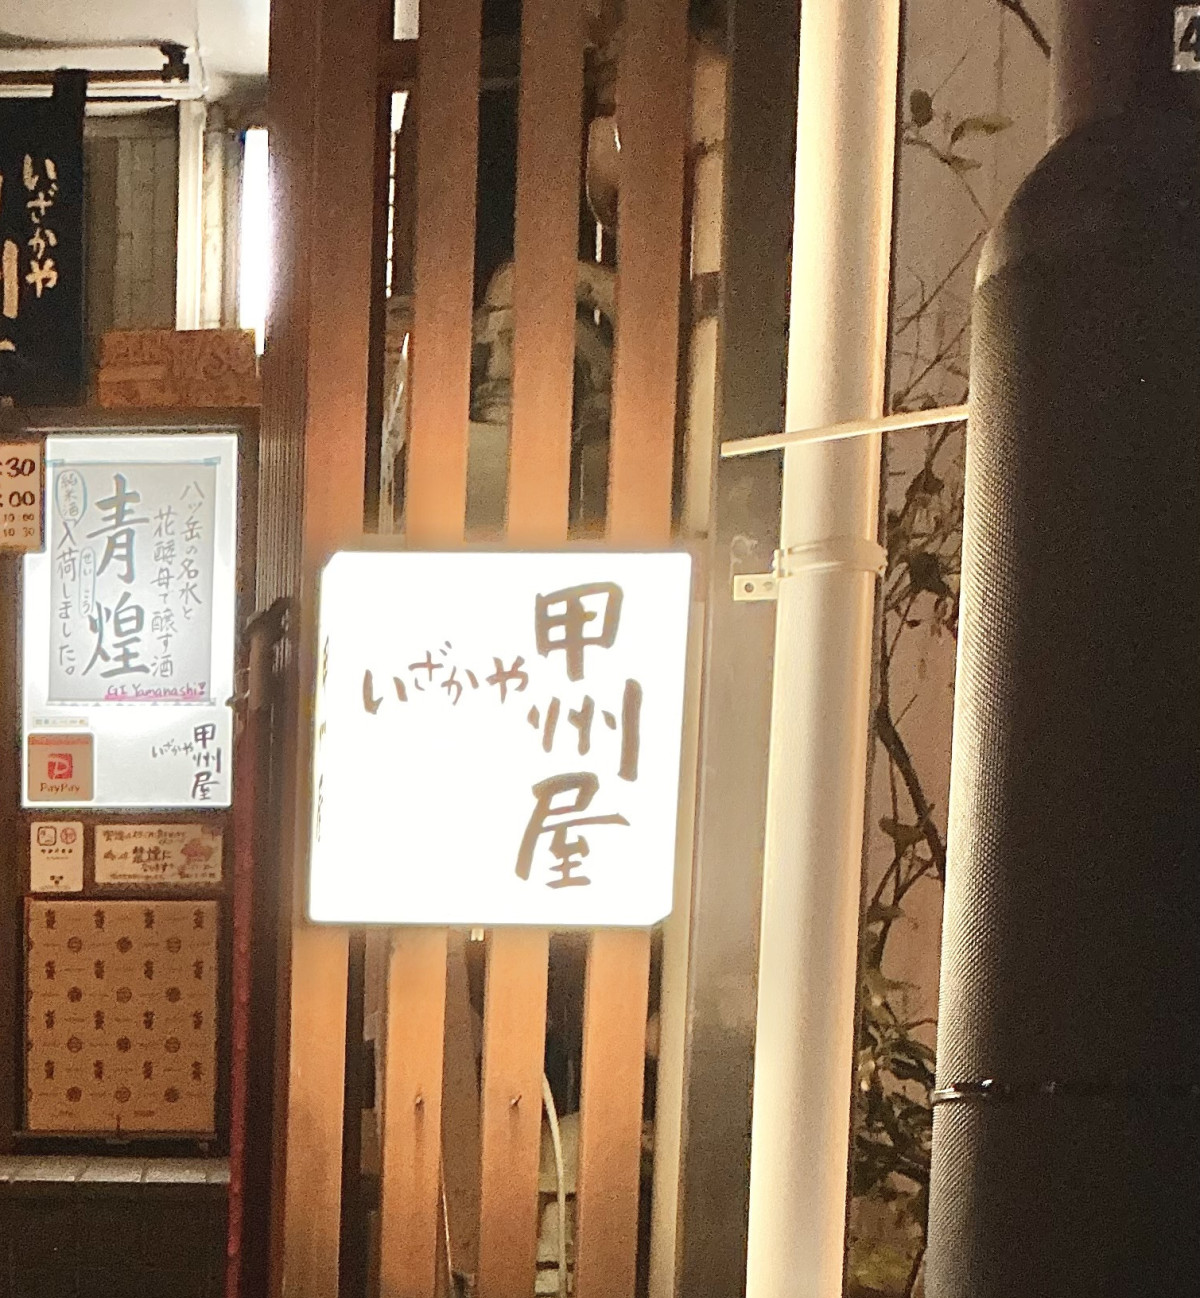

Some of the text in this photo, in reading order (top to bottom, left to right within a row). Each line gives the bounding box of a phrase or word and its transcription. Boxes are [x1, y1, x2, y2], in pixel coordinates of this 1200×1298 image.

[23, 154, 57, 298] いざかや
[56, 521, 79, 675] 入荷しました。
[82, 473, 150, 679] 青煌
[152, 739, 193, 758] いざかや
[362, 640, 529, 714] いざかや
[515, 581, 642, 889] 甲州屋
[191, 723, 222, 800] 甲州屋
